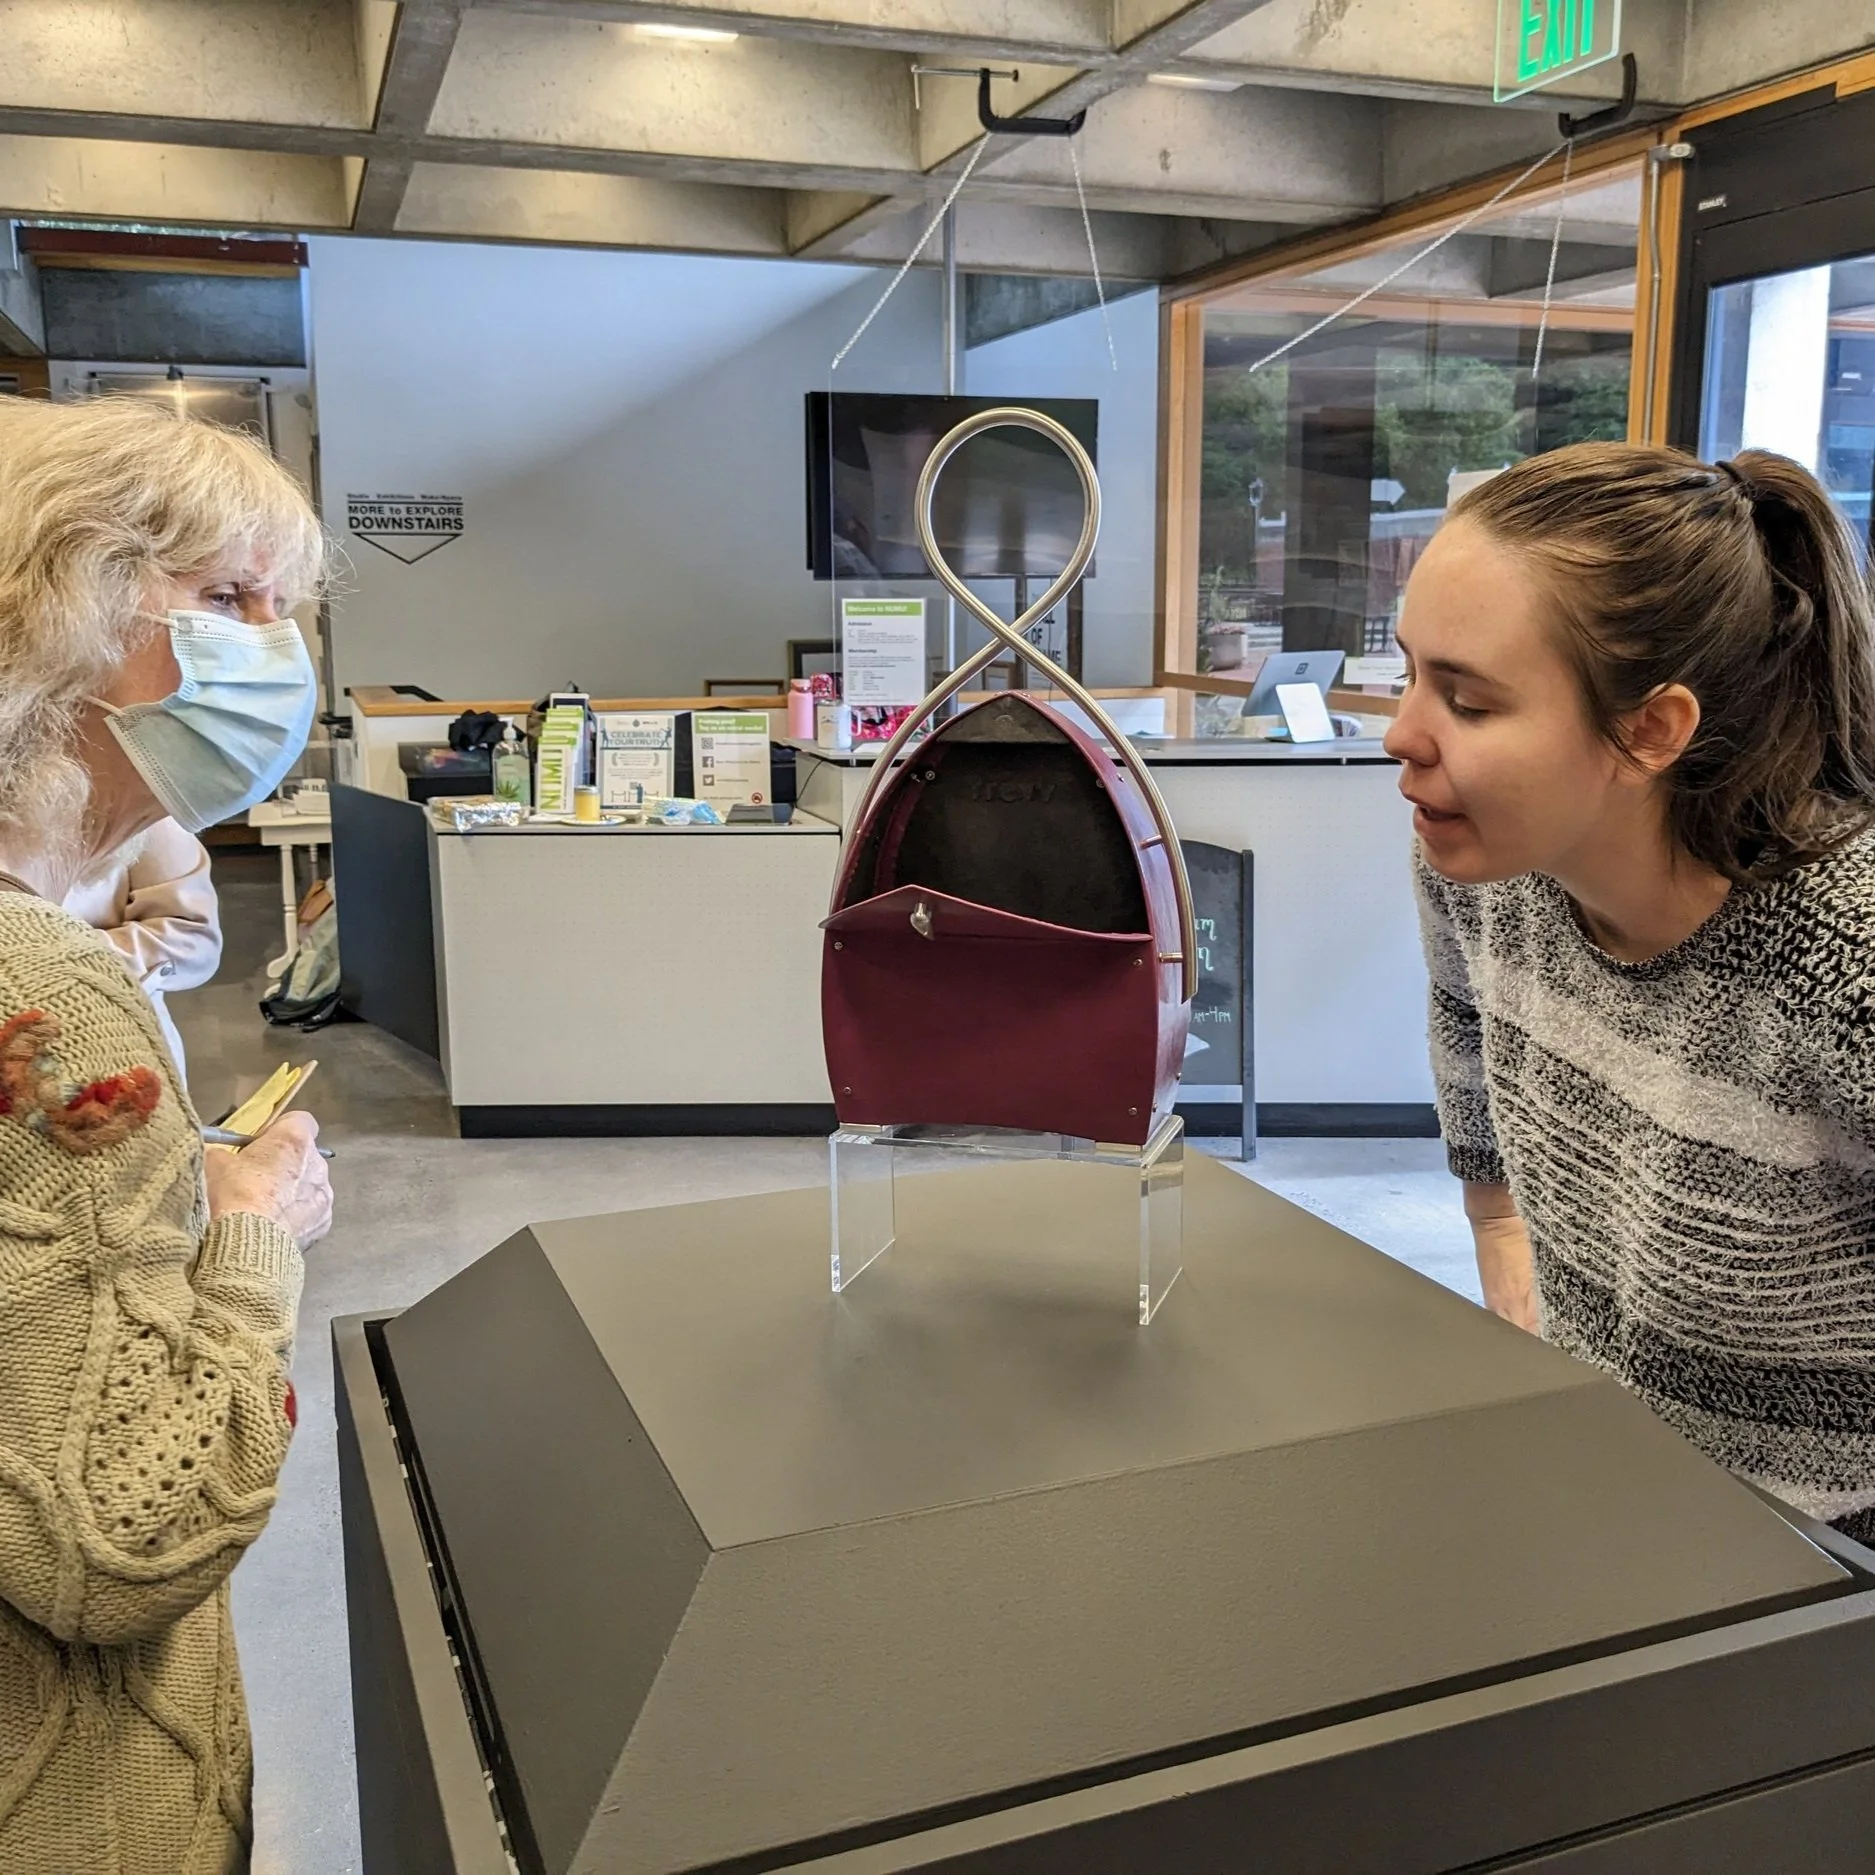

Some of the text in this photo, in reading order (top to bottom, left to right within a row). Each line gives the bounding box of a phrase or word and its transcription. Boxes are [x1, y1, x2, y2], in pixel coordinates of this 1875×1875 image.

[348, 505, 464, 516] MORE to EXPLORE
[348, 516, 464, 530] DOWNSTAIRS
[610, 731, 661, 739] CELEBRATE
